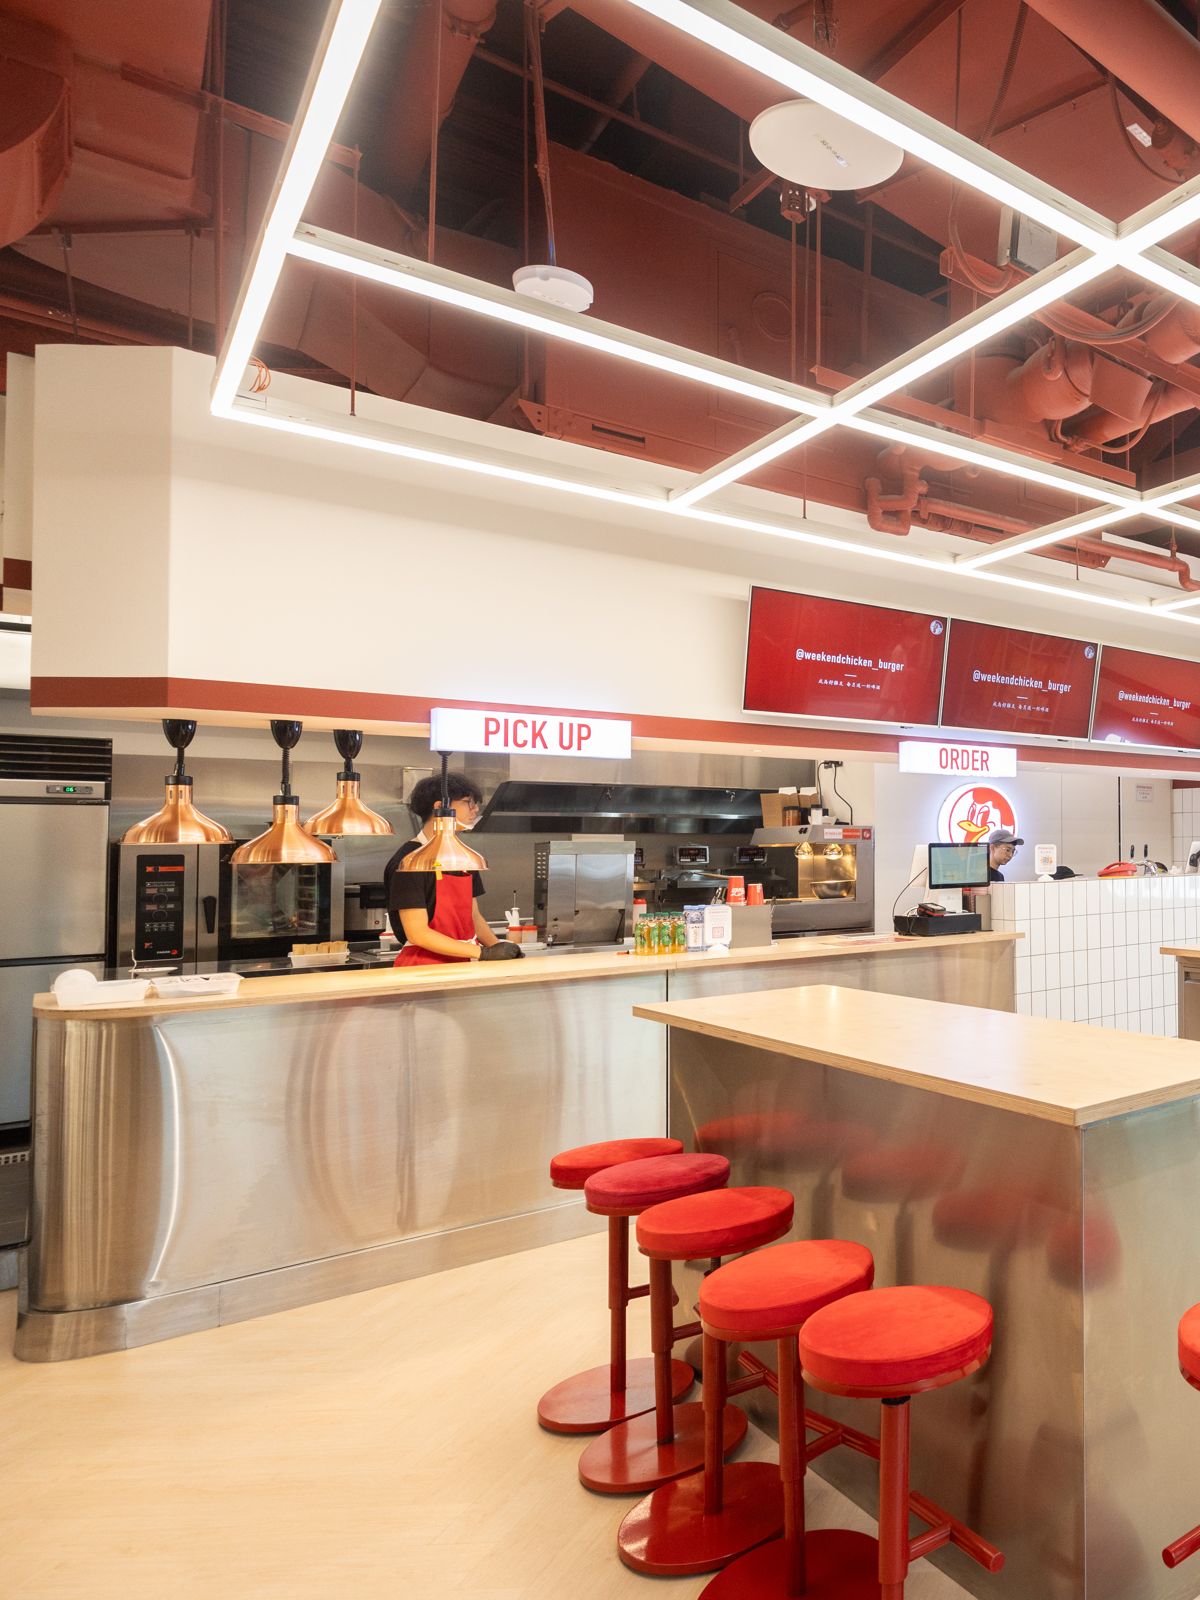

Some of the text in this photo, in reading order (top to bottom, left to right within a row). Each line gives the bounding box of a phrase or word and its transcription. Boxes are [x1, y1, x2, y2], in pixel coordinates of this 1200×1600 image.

[796, 648, 904, 672] @weekendchicken_burger
[973, 669, 1072, 694] @weekendchicken_burger
[1118, 690, 1191, 710] @weekendchicken_burger
[484, 716, 592, 751] PICK UP
[939, 747, 990, 772] ORDER
